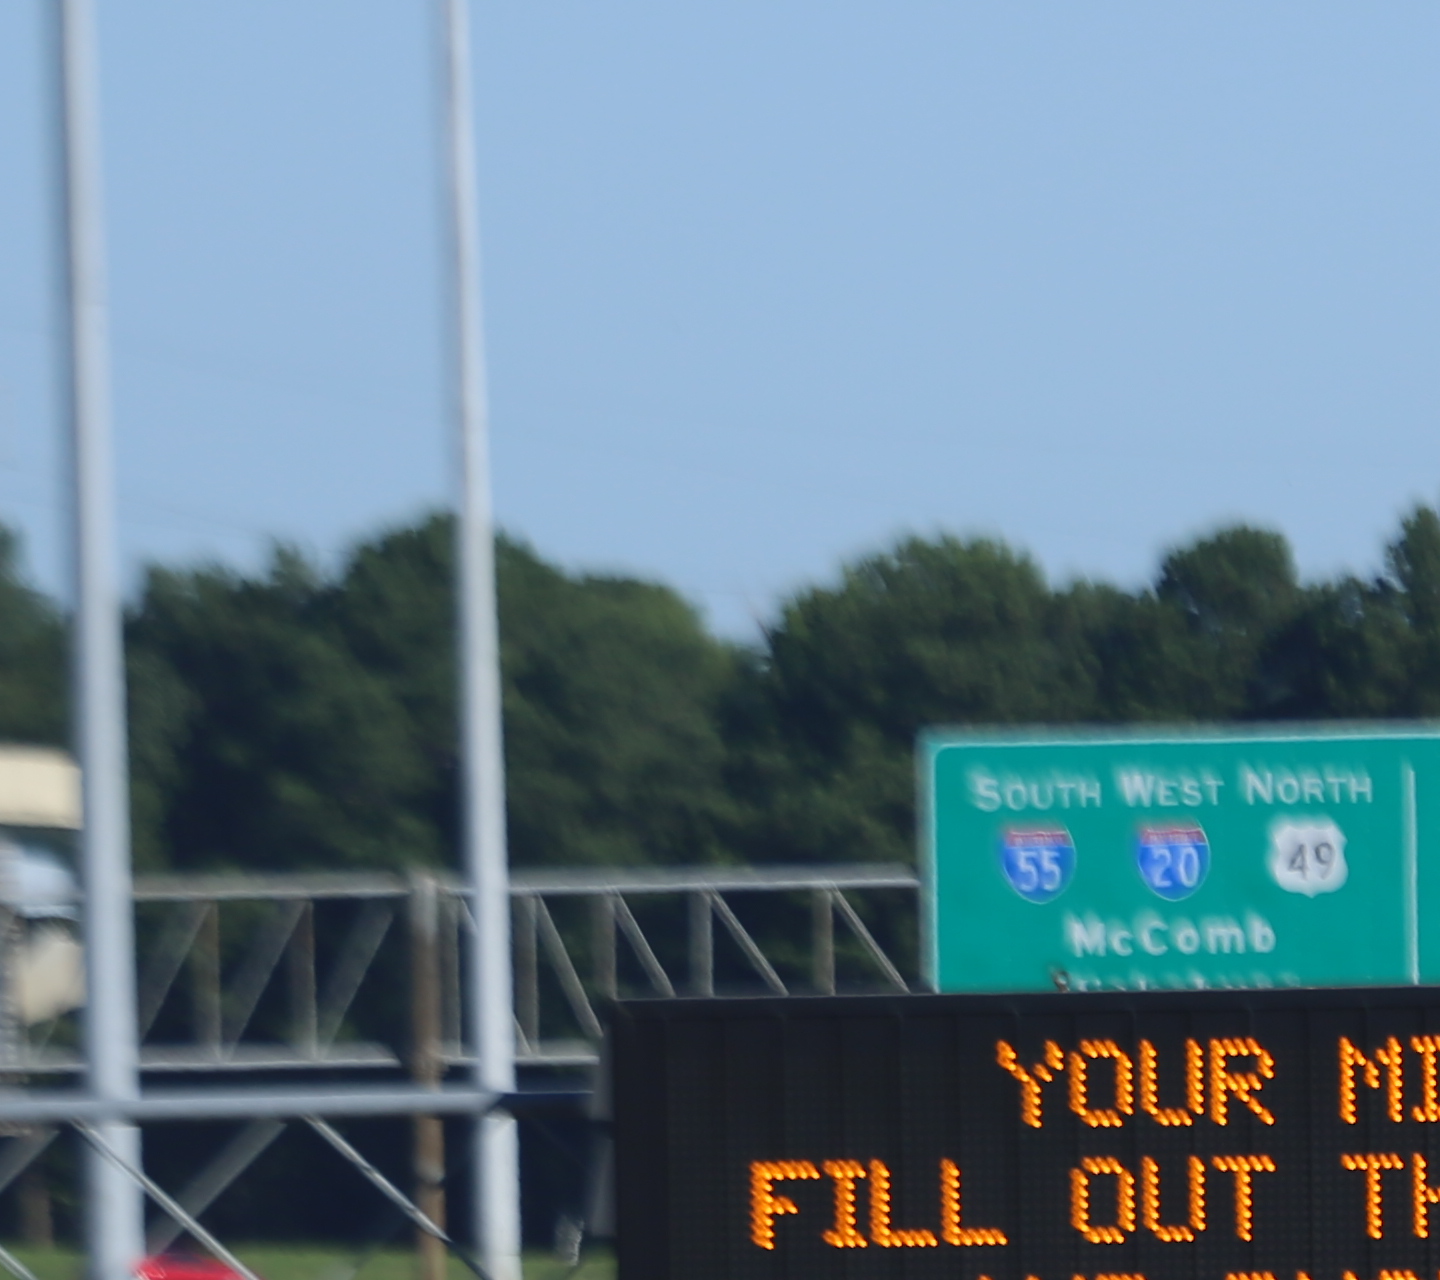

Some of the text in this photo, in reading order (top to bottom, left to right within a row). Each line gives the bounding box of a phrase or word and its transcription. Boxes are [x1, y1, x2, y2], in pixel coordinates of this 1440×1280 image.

[976, 763, 1372, 810] SOUTH WEST NORTH
[1017, 840, 1334, 891] 55 20 49
[1067, 915, 1277, 958] McComb
[998, 1037, 1275, 1128] YOUR
[751, 1159, 1008, 1250] FILL
[1071, 1155, 1276, 1244] OUT
